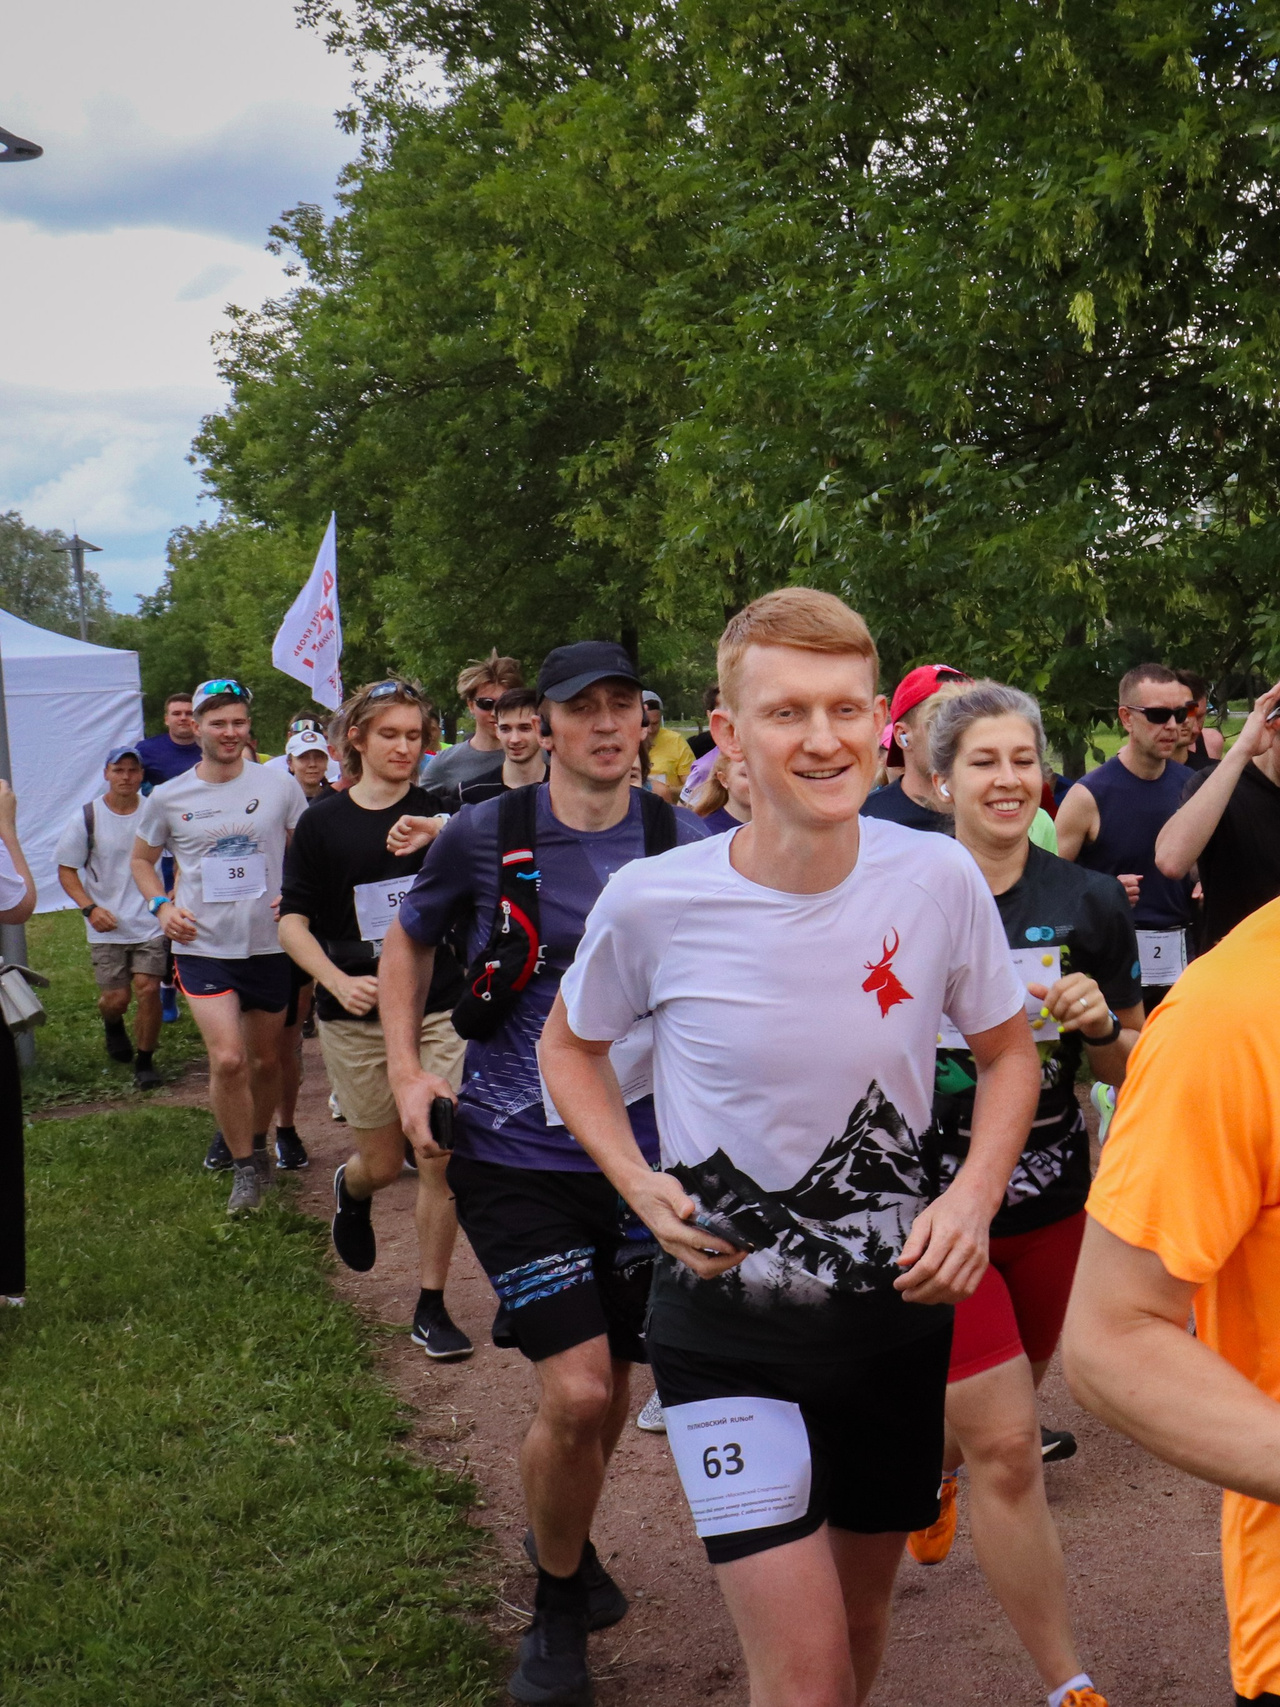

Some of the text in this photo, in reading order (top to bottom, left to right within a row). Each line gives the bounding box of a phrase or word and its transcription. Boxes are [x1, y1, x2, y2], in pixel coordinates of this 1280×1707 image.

[228, 866, 245, 879] 38
[1153, 946, 1162, 959] 2
[687, 1417, 727, 1431] ПУЛКОВСКИЙ
[702, 1442, 745, 1479] 63
